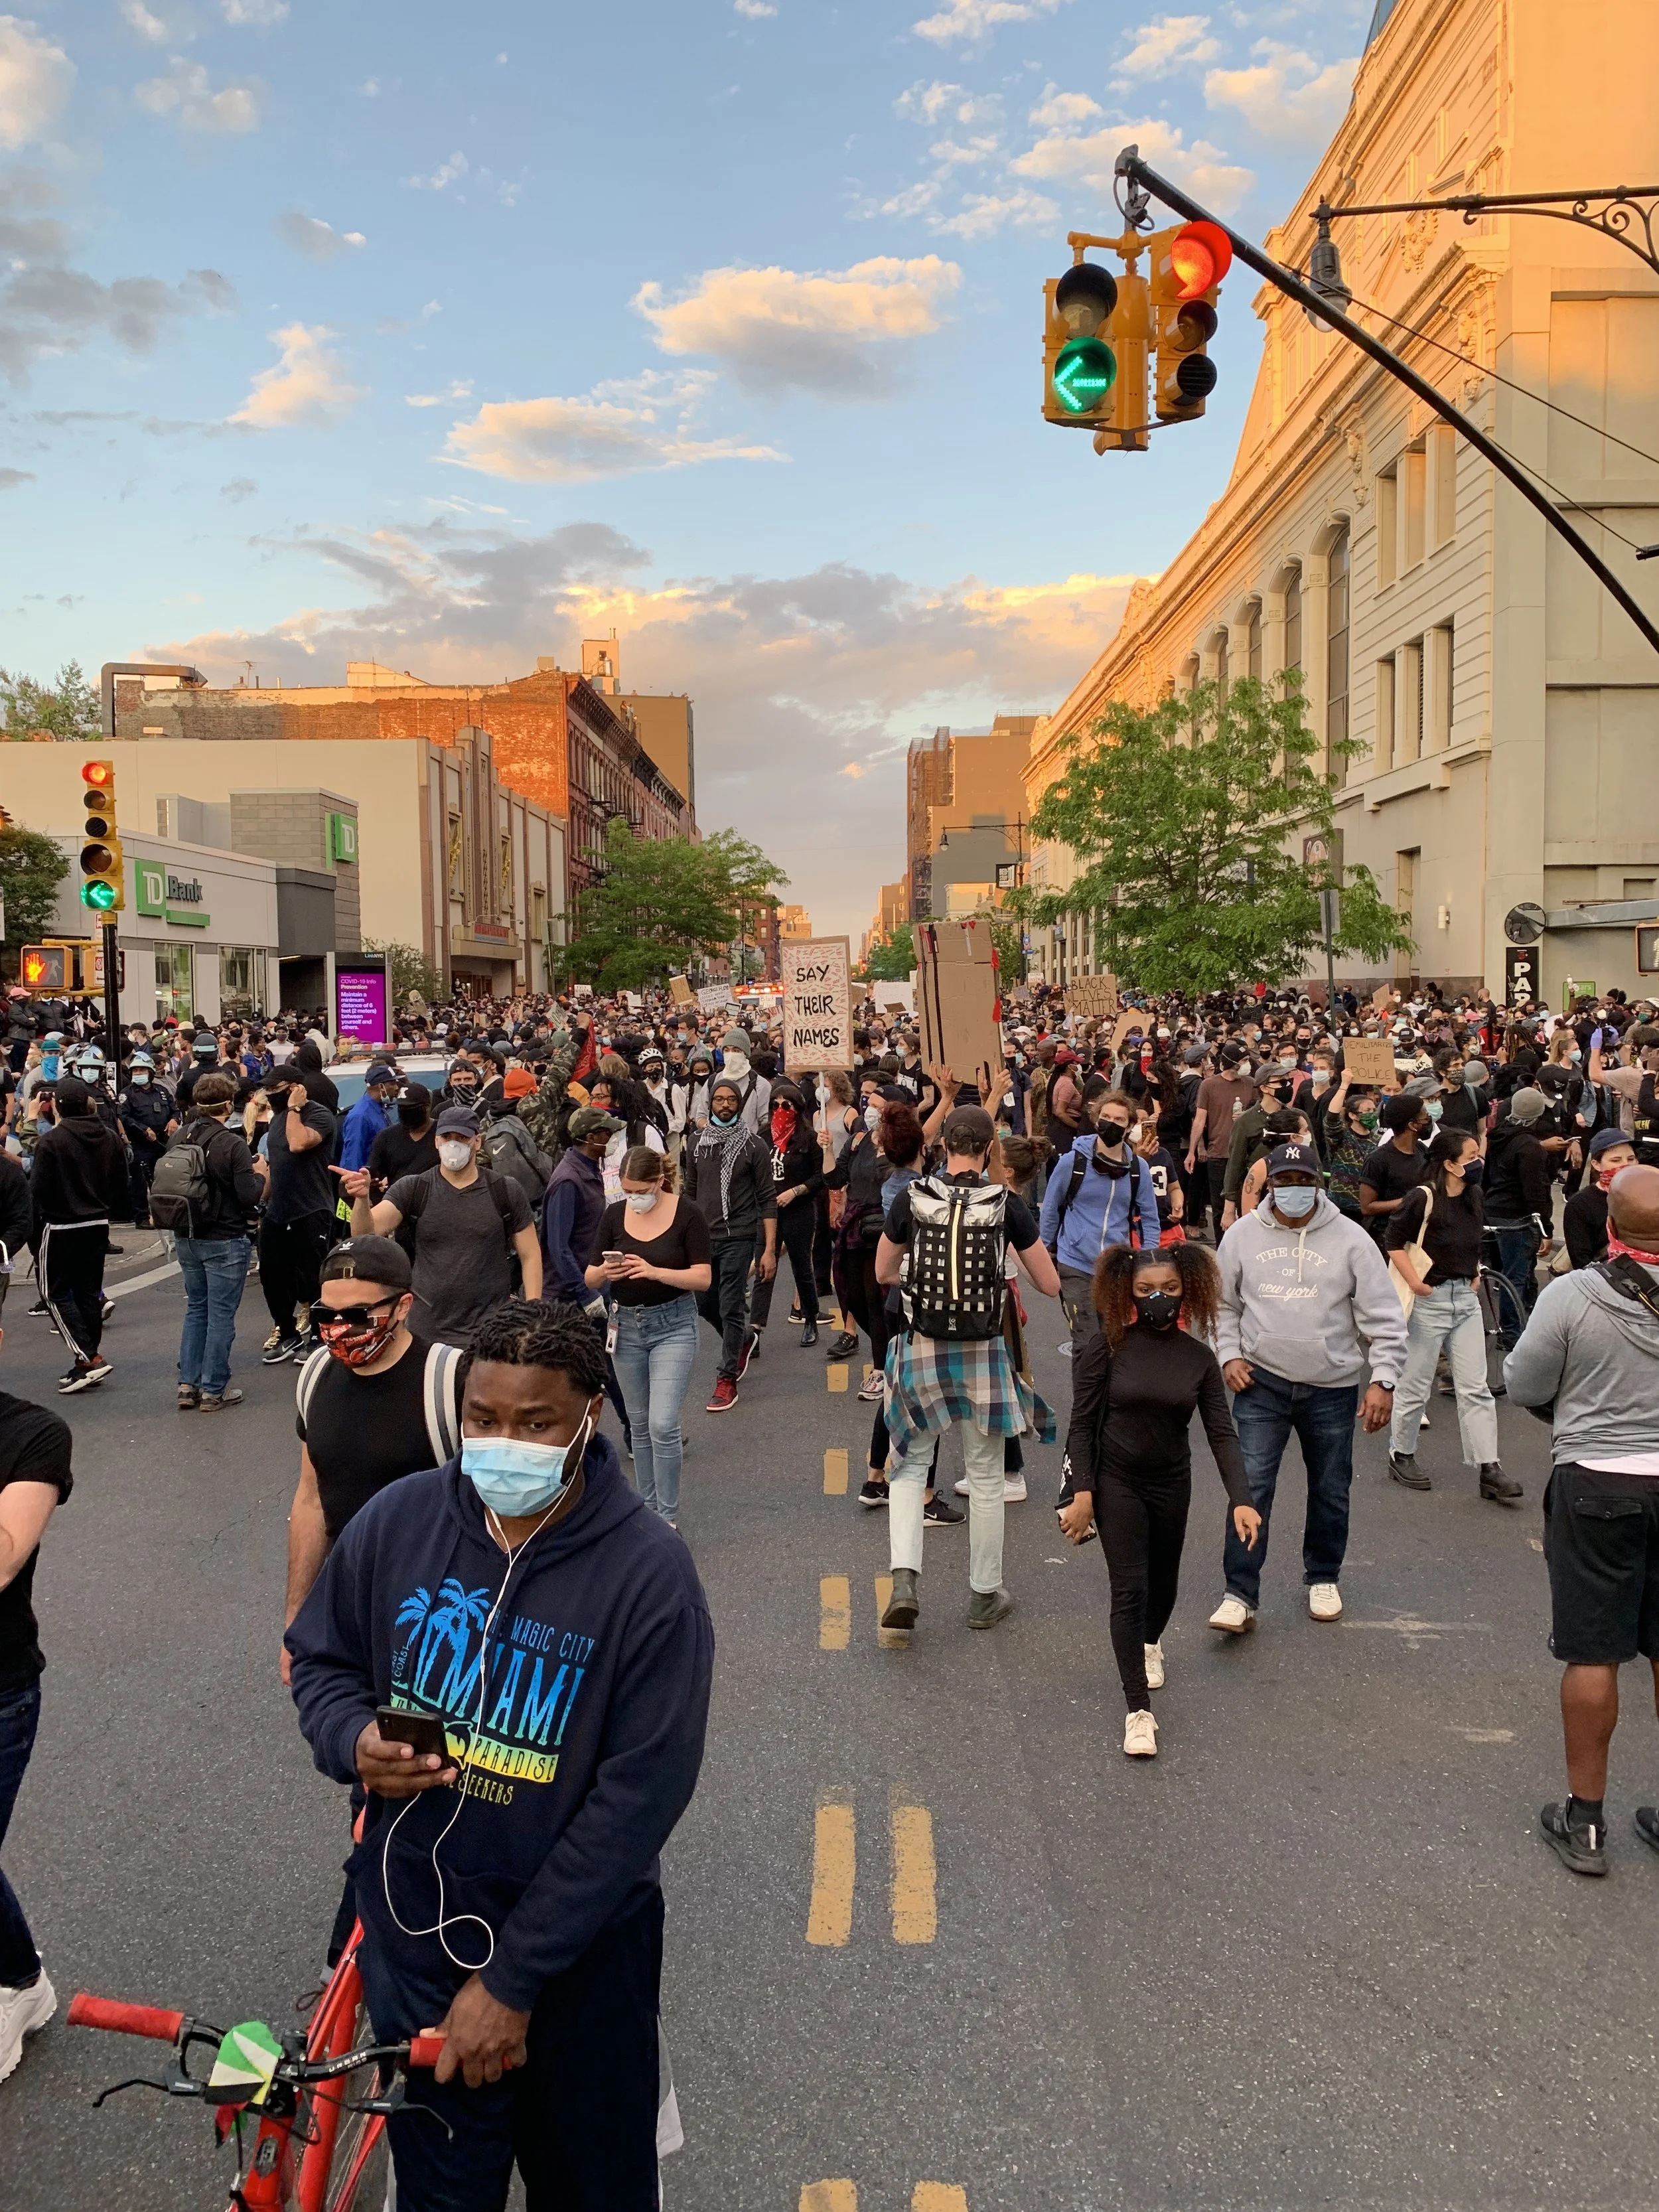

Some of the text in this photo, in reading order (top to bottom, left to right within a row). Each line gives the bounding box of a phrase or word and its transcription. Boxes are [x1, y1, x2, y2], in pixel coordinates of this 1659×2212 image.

[342, 824, 355, 853] TD
[143, 871, 203, 905] TD Bank
[796, 964, 830, 982] SAY
[1072, 977, 1108, 990] BLACK
[794, 994, 836, 1016] THEIR
[1072, 988, 1112, 1002] LIVES
[1072, 998, 1116, 1017] MATTER
[793, 1027, 839, 1048] NAMES
[1357, 1053, 1381, 1063] THE
[1351, 1066, 1392, 1080] POLICE
[1285, 1146, 1301, 1159] NY
[1256, 1247, 1328, 1268] THE CITY
[1281, 1268, 1295, 1277] OF
[1258, 1281, 1319, 1301] new york
[510, 1615, 555, 1653] MAGIC
[559, 1631, 595, 1663] CITY
[435, 1626, 585, 1746] MIAMI
[472, 1736, 557, 1781] PARADISE
[458, 1772, 514, 1806] SEEKERS
